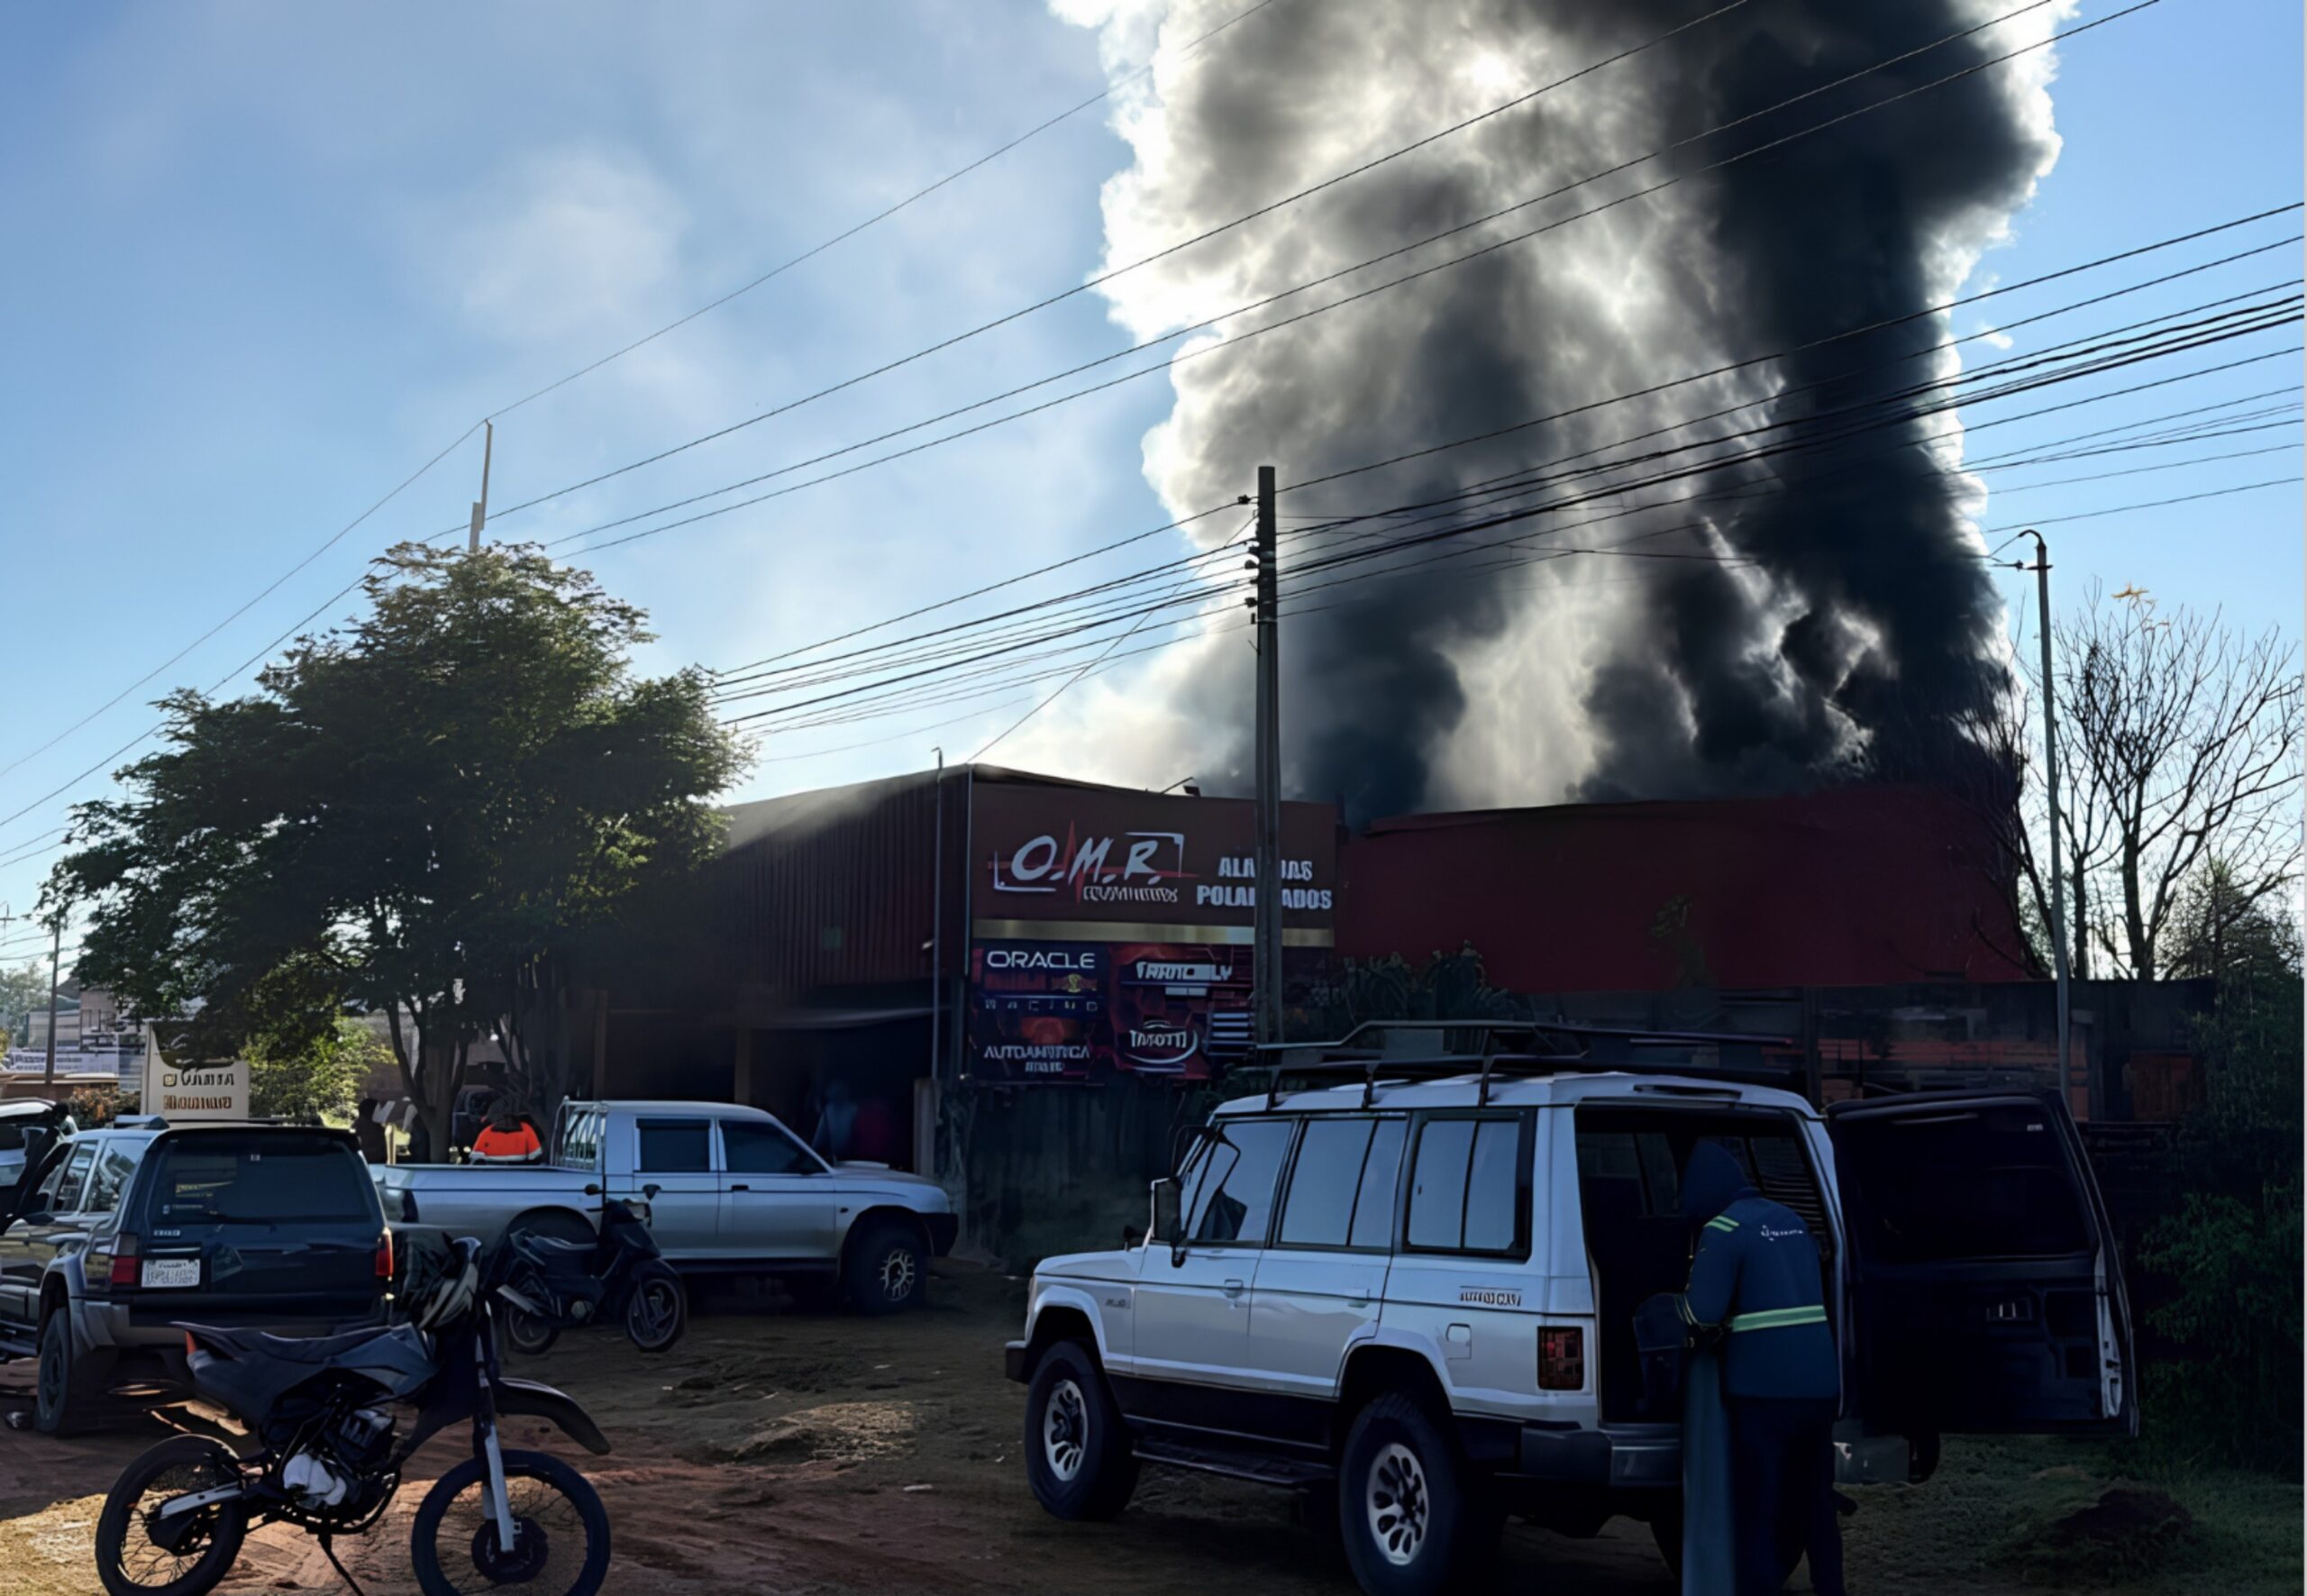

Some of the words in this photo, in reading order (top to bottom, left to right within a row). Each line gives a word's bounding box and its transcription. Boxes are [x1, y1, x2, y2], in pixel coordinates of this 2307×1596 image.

[1010, 834, 1163, 886] O.M.R.
[1217, 857, 1313, 881] ALAAS
[1196, 885, 1333, 910] POLAADOS
[987, 950, 1096, 969] ORACLE
